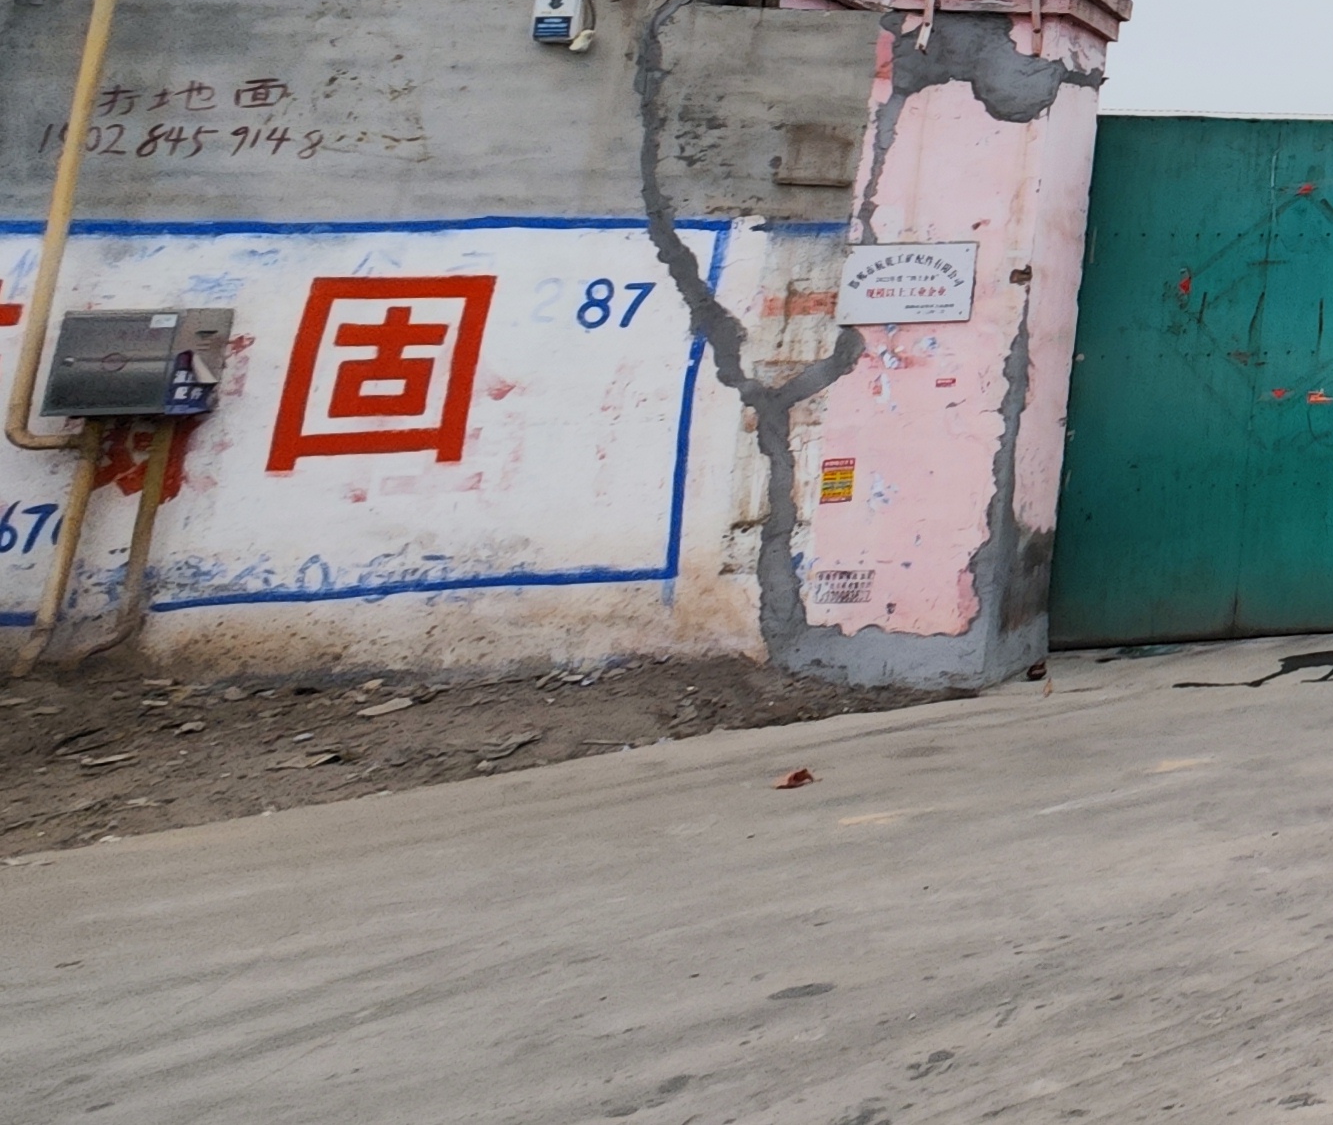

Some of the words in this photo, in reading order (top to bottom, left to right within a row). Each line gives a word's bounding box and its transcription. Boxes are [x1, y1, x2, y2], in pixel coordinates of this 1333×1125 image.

[97, 78, 292, 116] 打地面
[265, 275, 497, 473] 固
